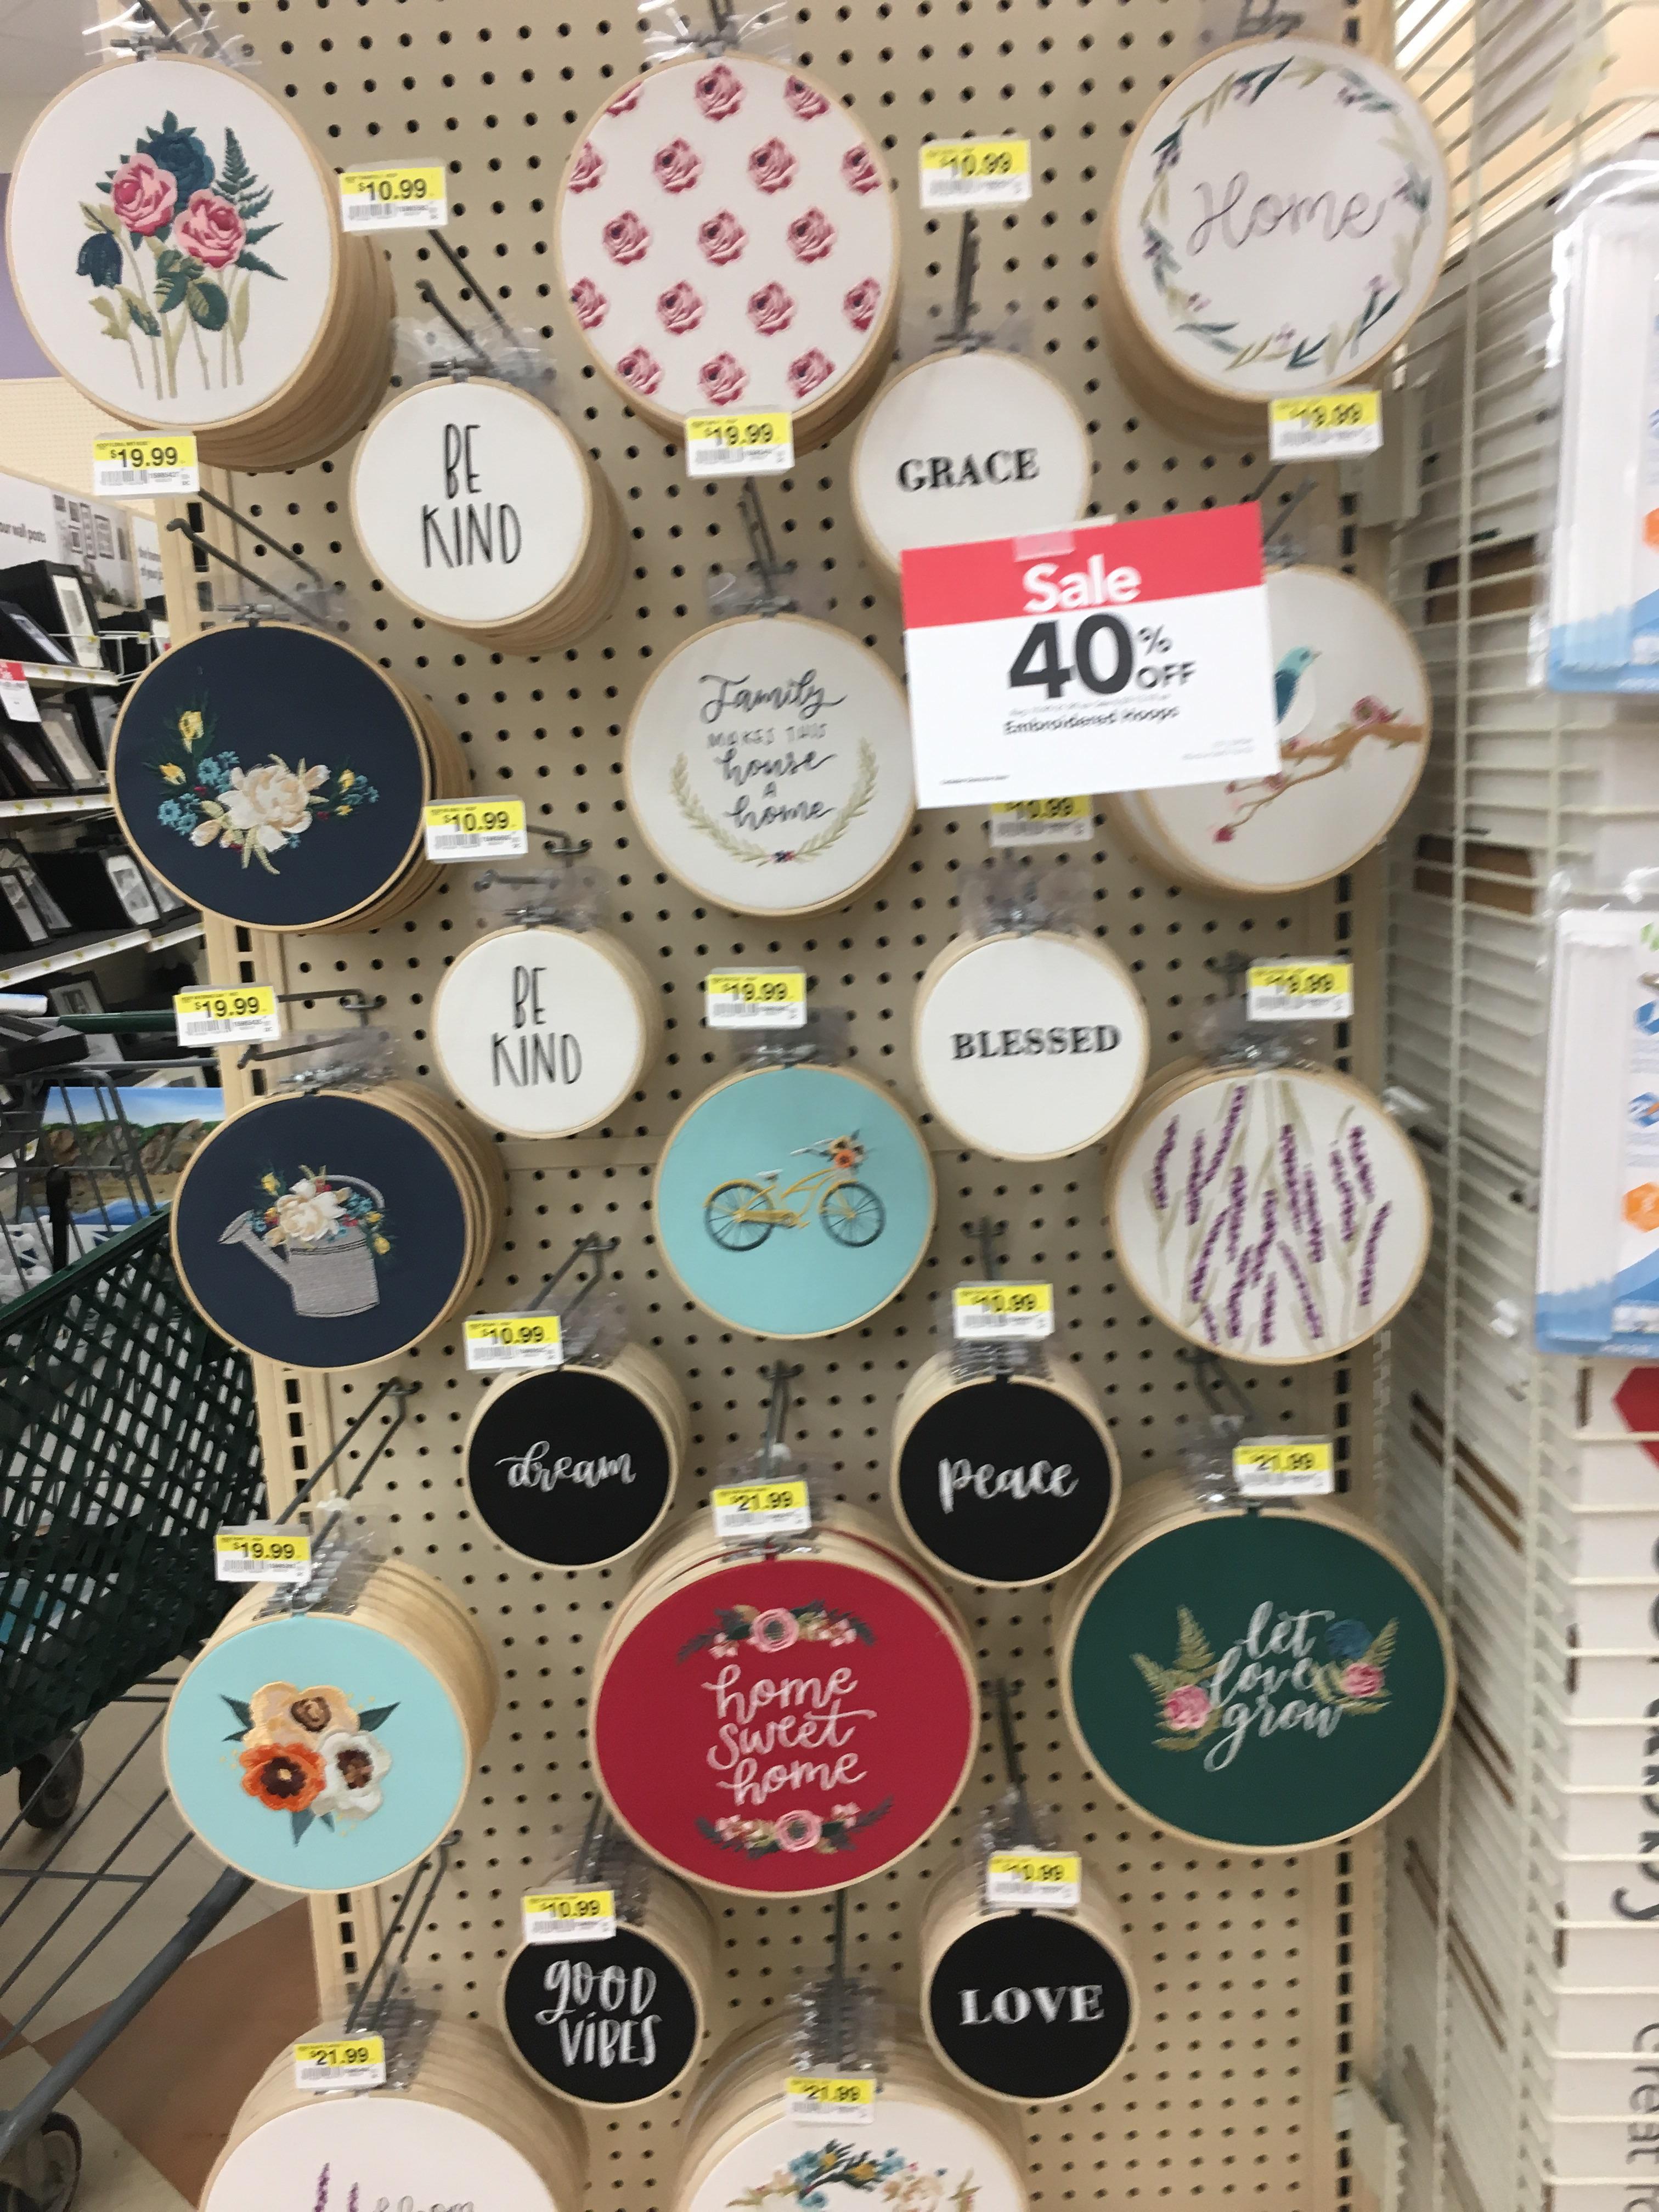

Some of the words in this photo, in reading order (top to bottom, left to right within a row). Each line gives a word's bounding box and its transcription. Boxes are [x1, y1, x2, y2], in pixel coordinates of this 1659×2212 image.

[1186, 171, 1387, 256] Home
[443, 424, 482, 500] BE
[895, 448, 1040, 492] GRACE
[420, 503, 522, 568] KIND
[1022, 553, 1142, 613] Sale
[698, 669, 848, 724] Family
[1136, 661, 1197, 691] OFF
[1003, 709, 1118, 735] Embroidered
[1120, 706, 1180, 724] Hoops
[713, 748, 837, 786] house
[723, 795, 837, 832] home
[512, 966, 547, 1030] BE
[491, 1032, 582, 1088] KIND
[950, 1025, 1122, 1061] BLESSED
[494, 1441, 636, 1492] dream
[938, 1457, 1079, 1514] peace
[1234, 1601, 1335, 1660] let
[701, 1664, 859, 1724] home
[1199, 1646, 1315, 1709] love
[707, 1698, 877, 1770] sweet
[1204, 1694, 1344, 1772] grow
[716, 1753, 868, 1806] home
[958, 1984, 1105, 2025] LOVE
